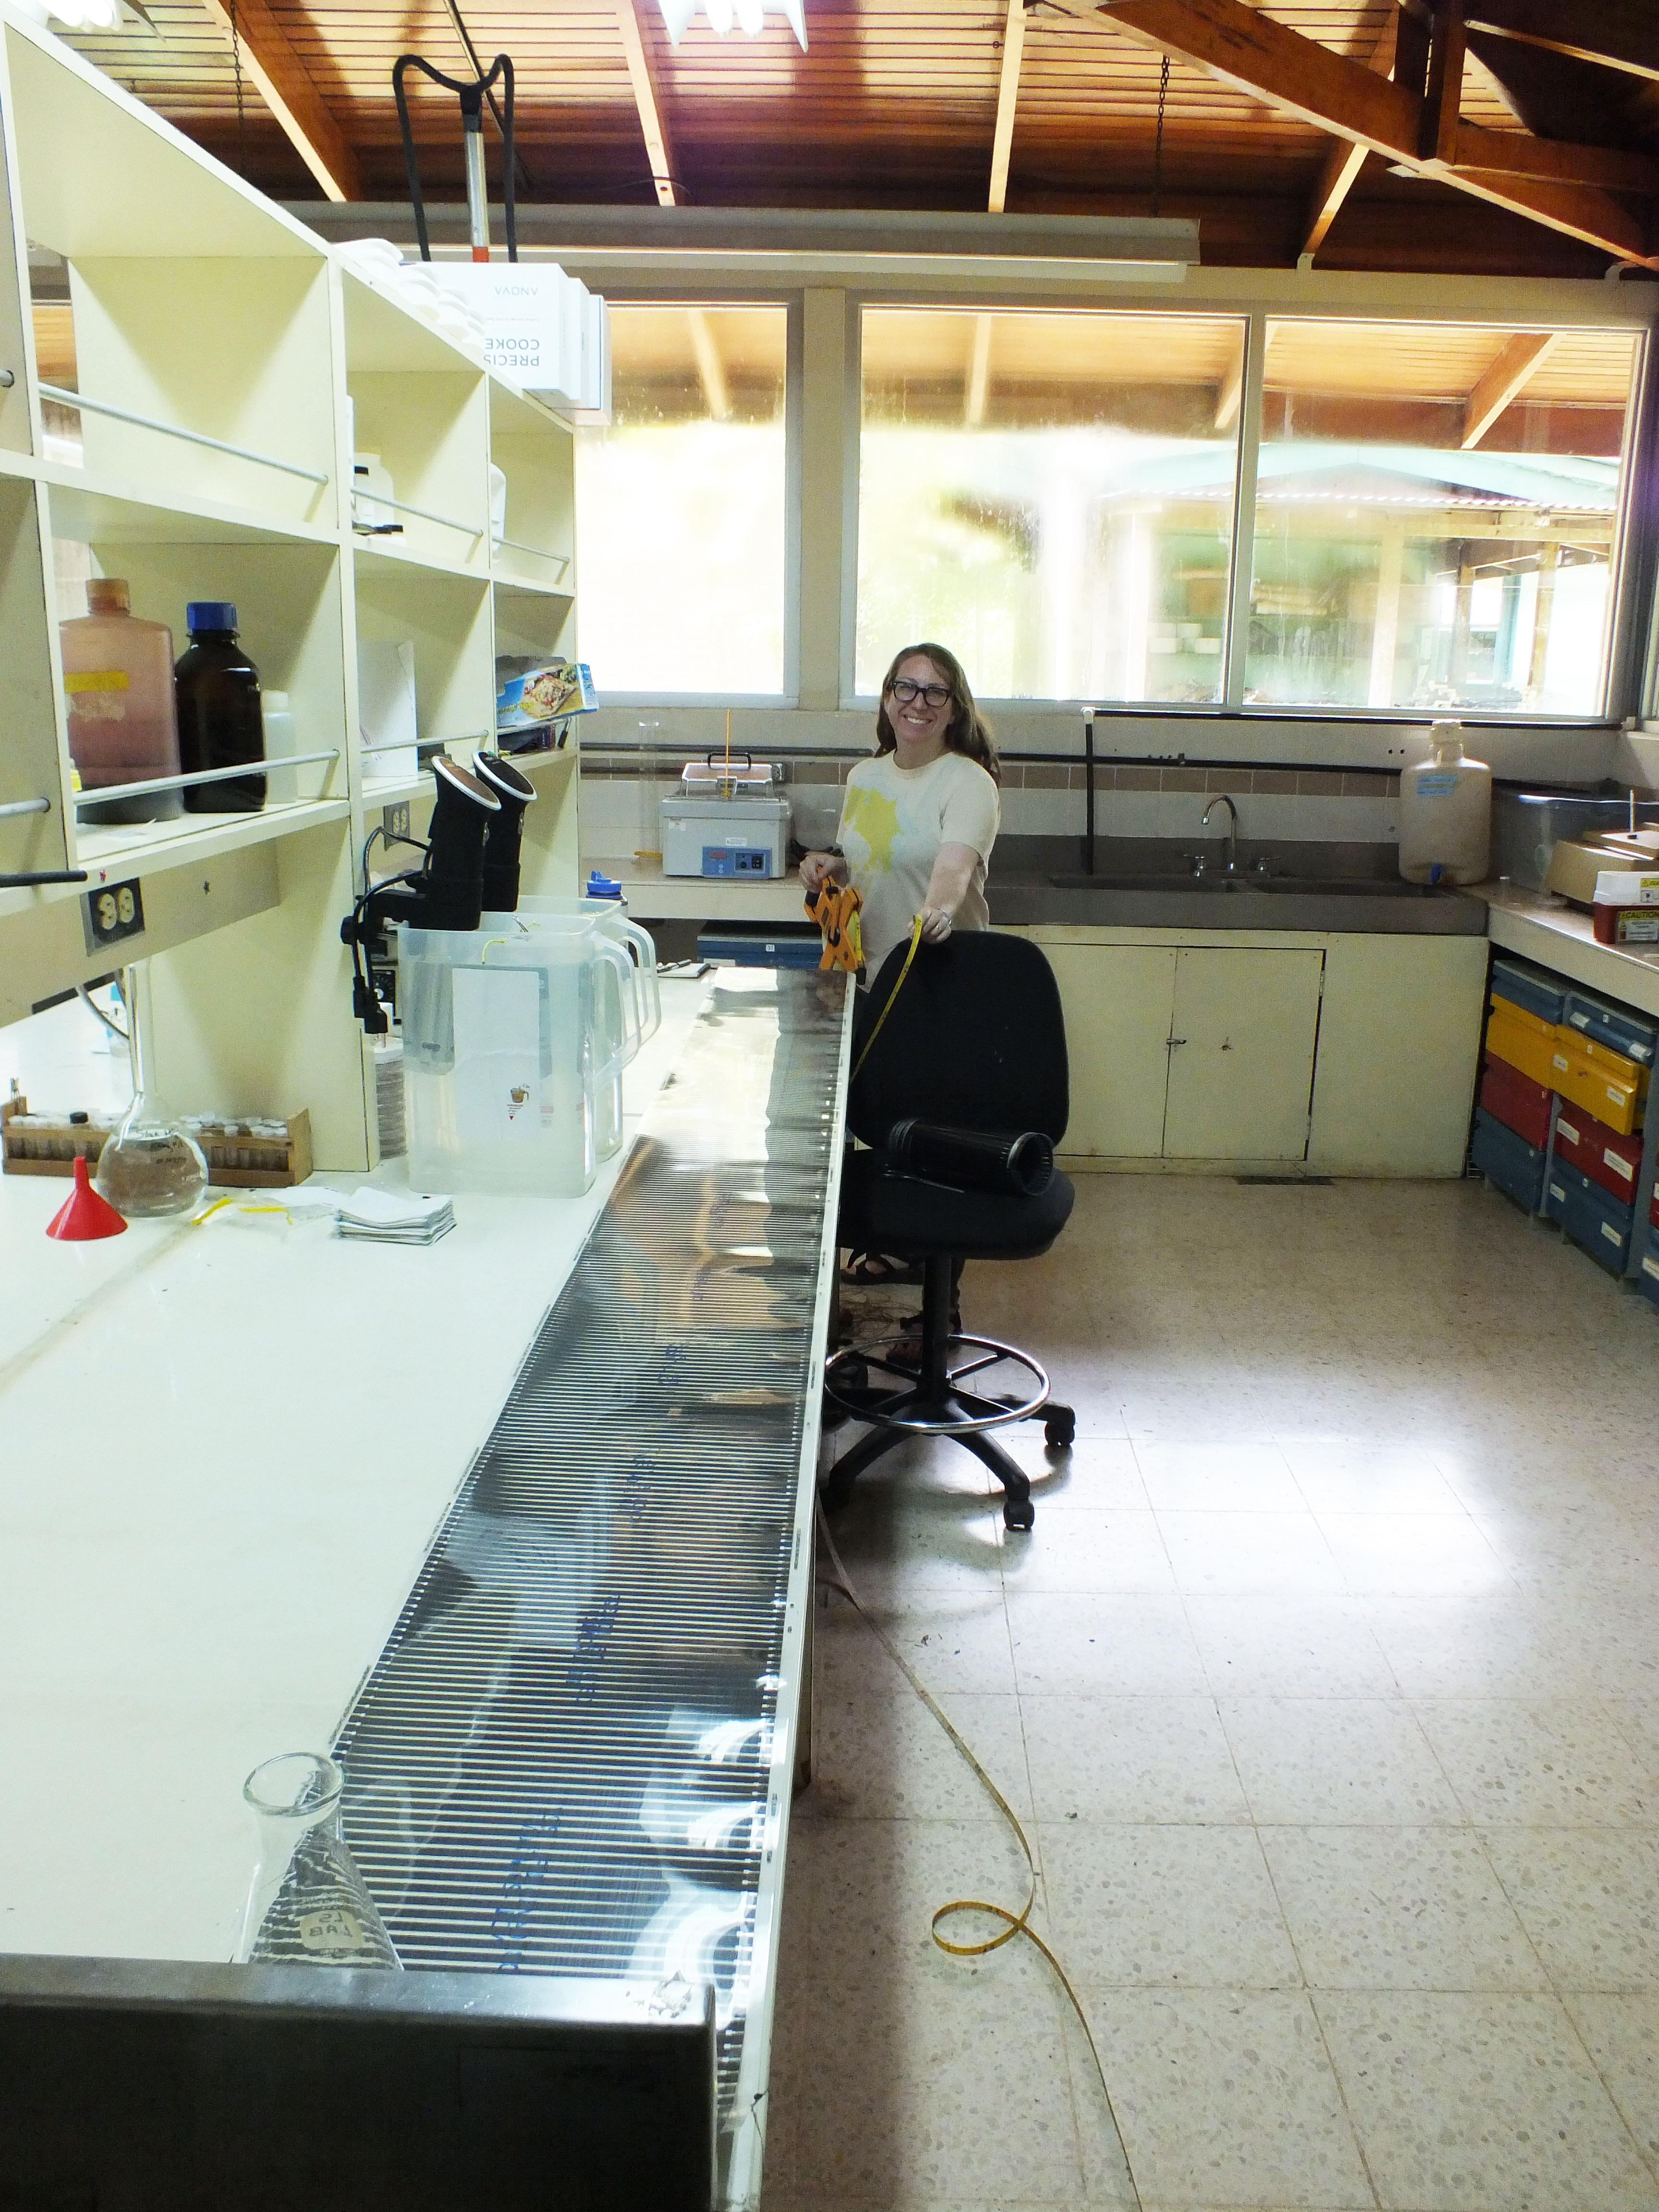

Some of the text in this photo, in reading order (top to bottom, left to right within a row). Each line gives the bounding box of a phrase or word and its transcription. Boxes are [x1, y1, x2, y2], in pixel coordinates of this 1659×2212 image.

[495, 287, 538, 295] ANOVA
[484, 338, 540, 350] COOKE
[483, 354, 540, 366] PRECIS
